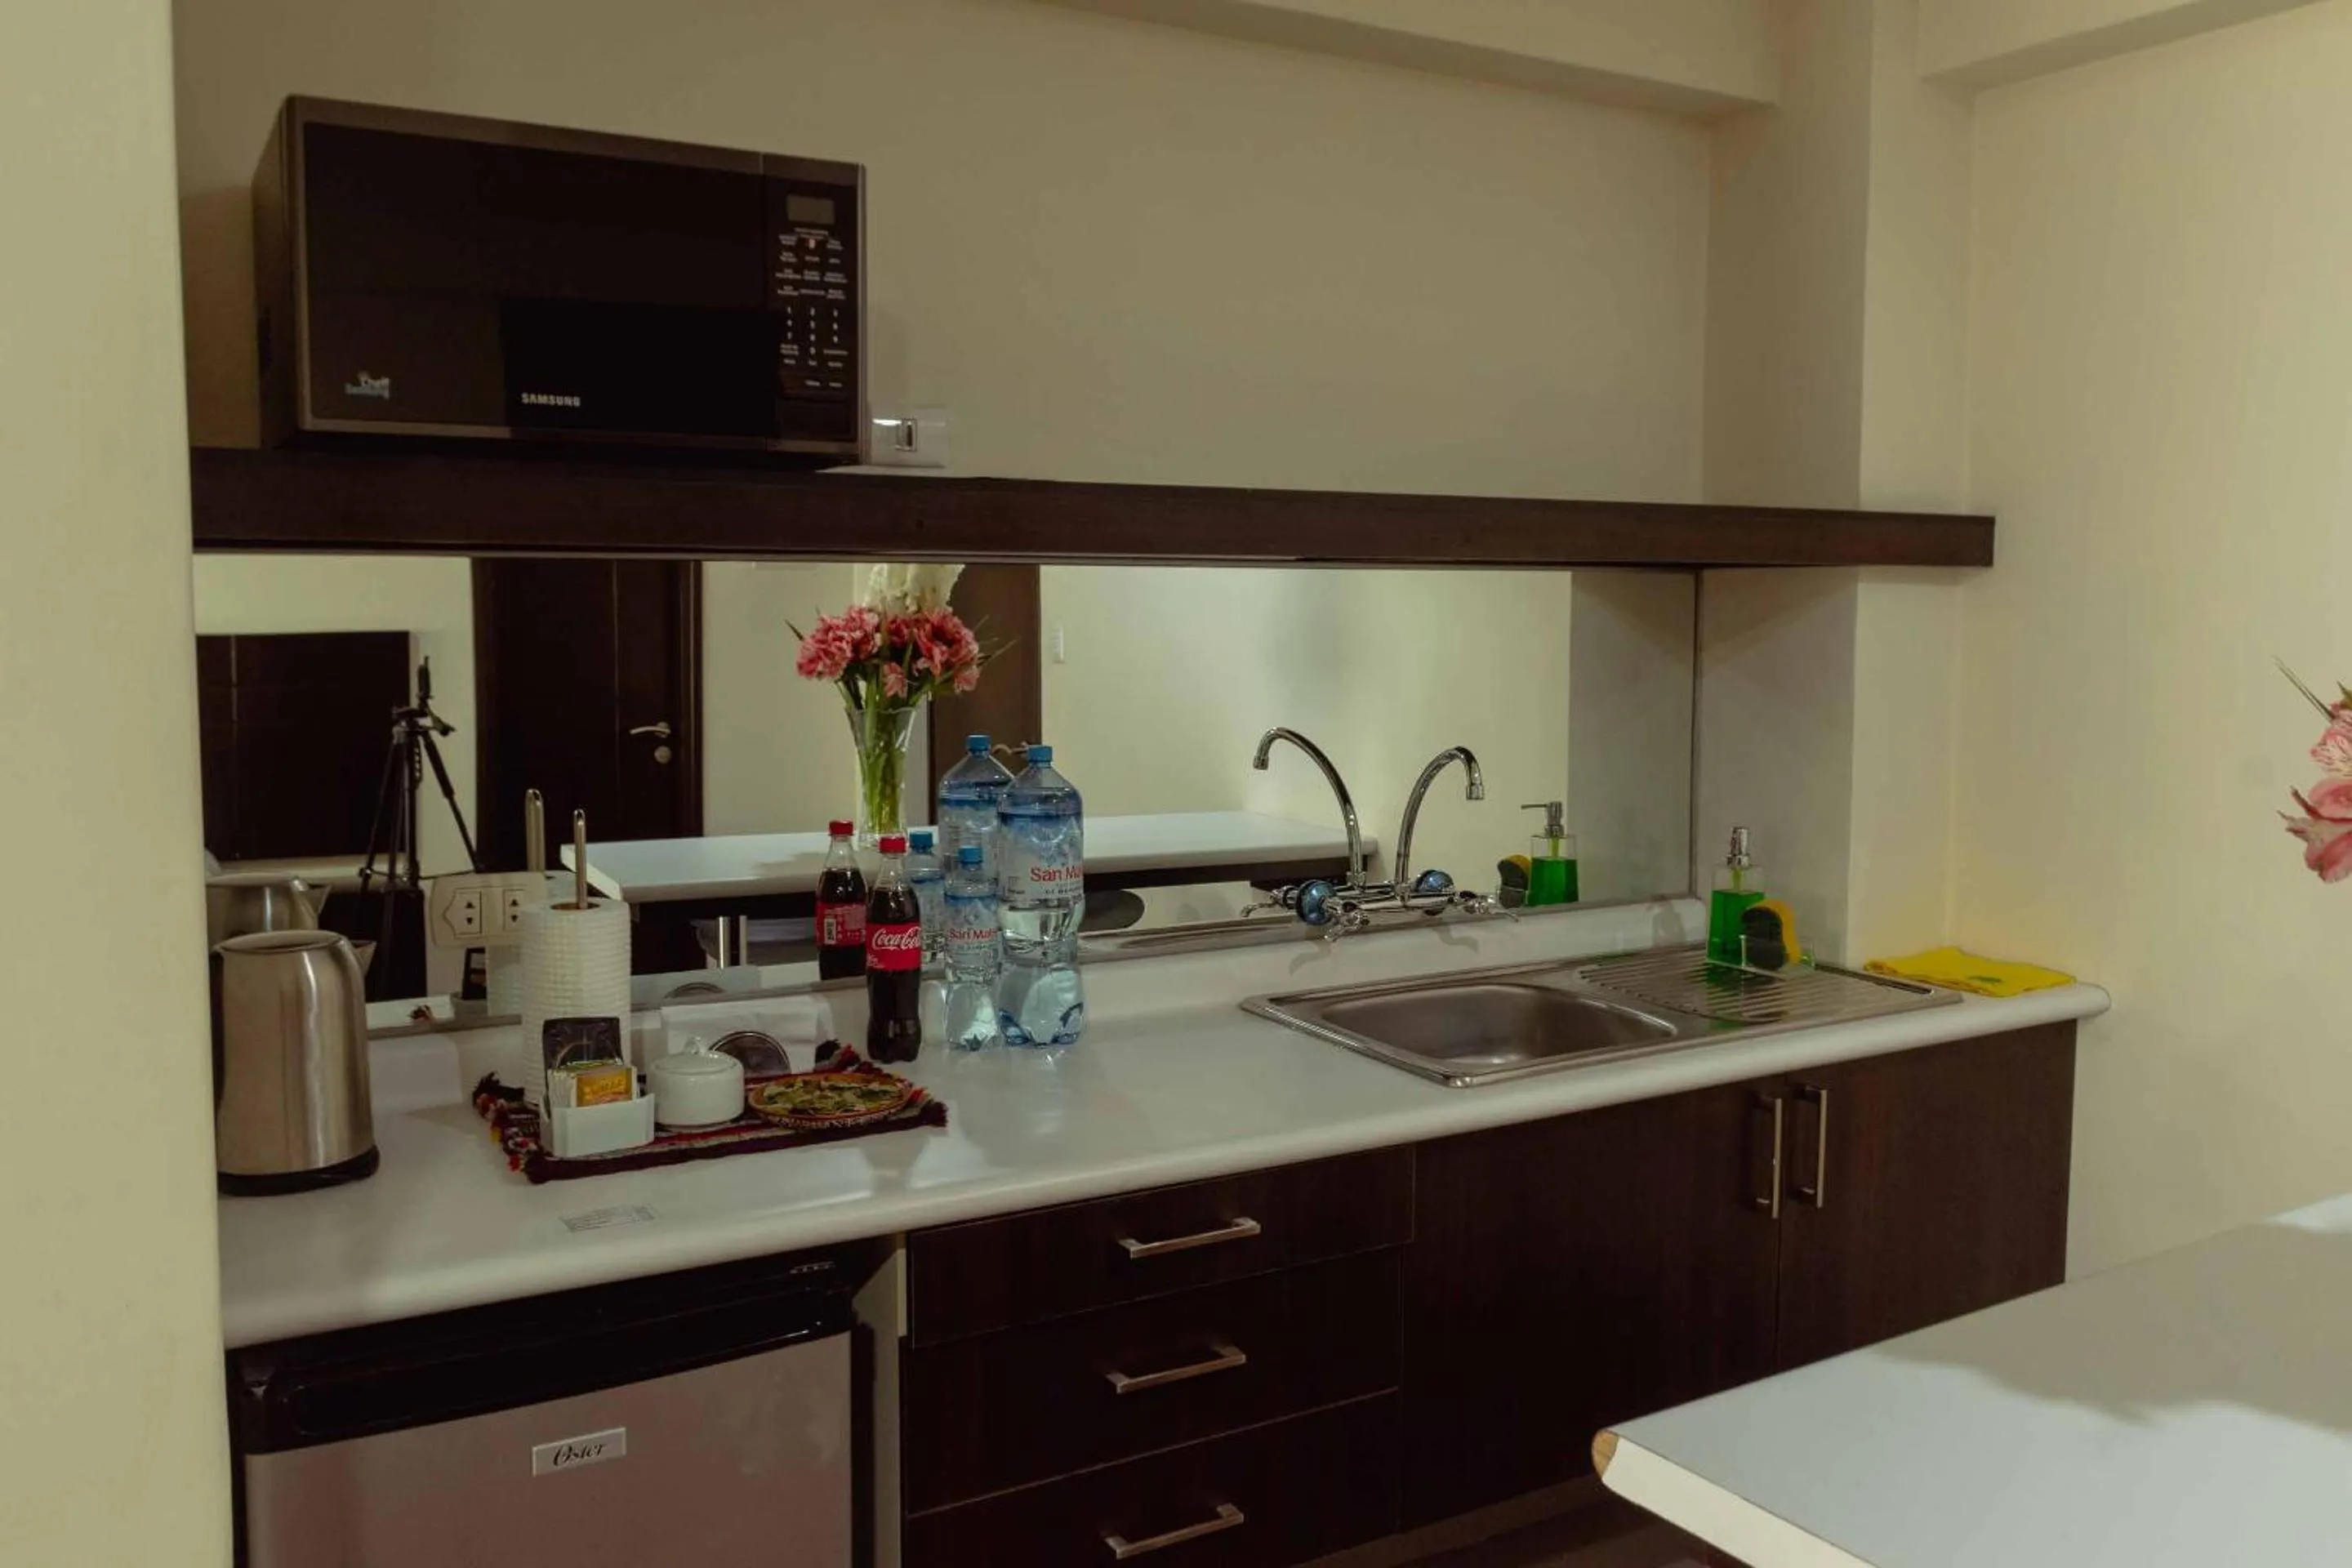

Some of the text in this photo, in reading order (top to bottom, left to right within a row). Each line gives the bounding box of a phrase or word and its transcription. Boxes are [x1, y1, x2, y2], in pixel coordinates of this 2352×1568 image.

[520, 392, 581, 408] SAMSUNG
[1030, 866, 1062, 882] San
[871, 926, 921, 951] Coca-Col
[950, 928, 970, 940] San
[552, 1443, 604, 1467] Oster
